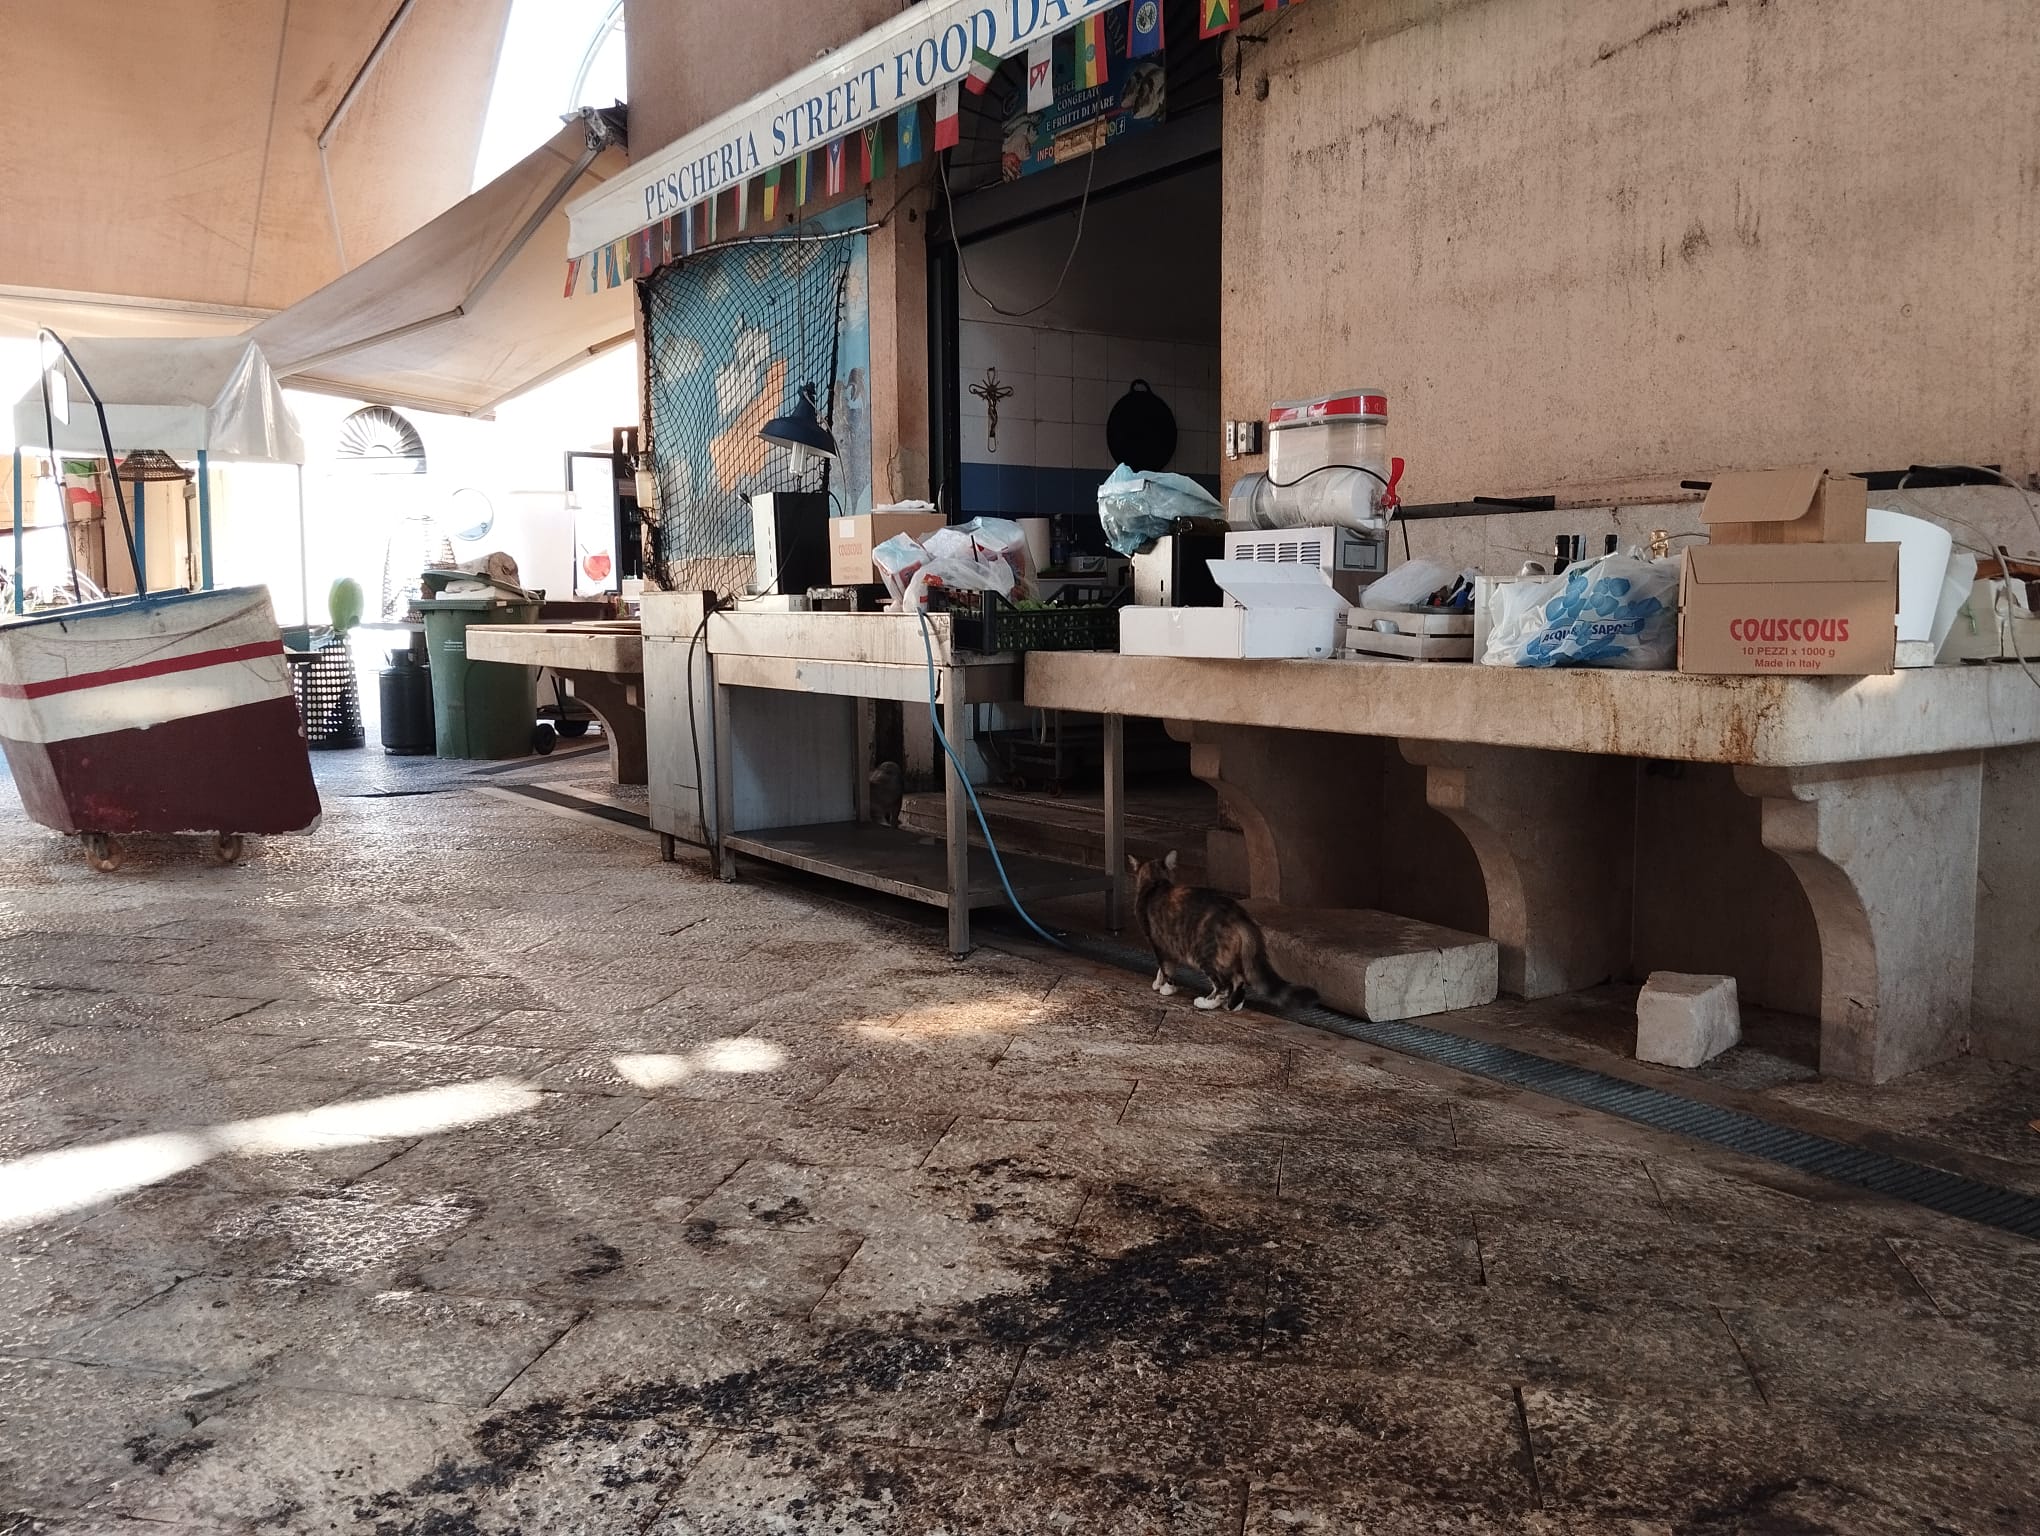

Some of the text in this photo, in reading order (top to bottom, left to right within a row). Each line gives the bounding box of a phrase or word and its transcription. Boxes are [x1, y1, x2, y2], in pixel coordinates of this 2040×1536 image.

[644, 130, 761, 221] PESCHERIA
[772, 63, 885, 157] STREET
[894, 9, 997, 100] FOOD
[1052, 109, 1080, 129] FRUTTI
[1081, 105, 1090, 118] DI
[1091, 95, 1115, 114] MARE
[1037, 146, 1054, 162] INFO
[1730, 618, 1849, 642] COUSCOUS
[1742, 646, 1836, 658] 10 PEZZI x 1000 g
[1754, 659, 1821, 669] Made in Italy
